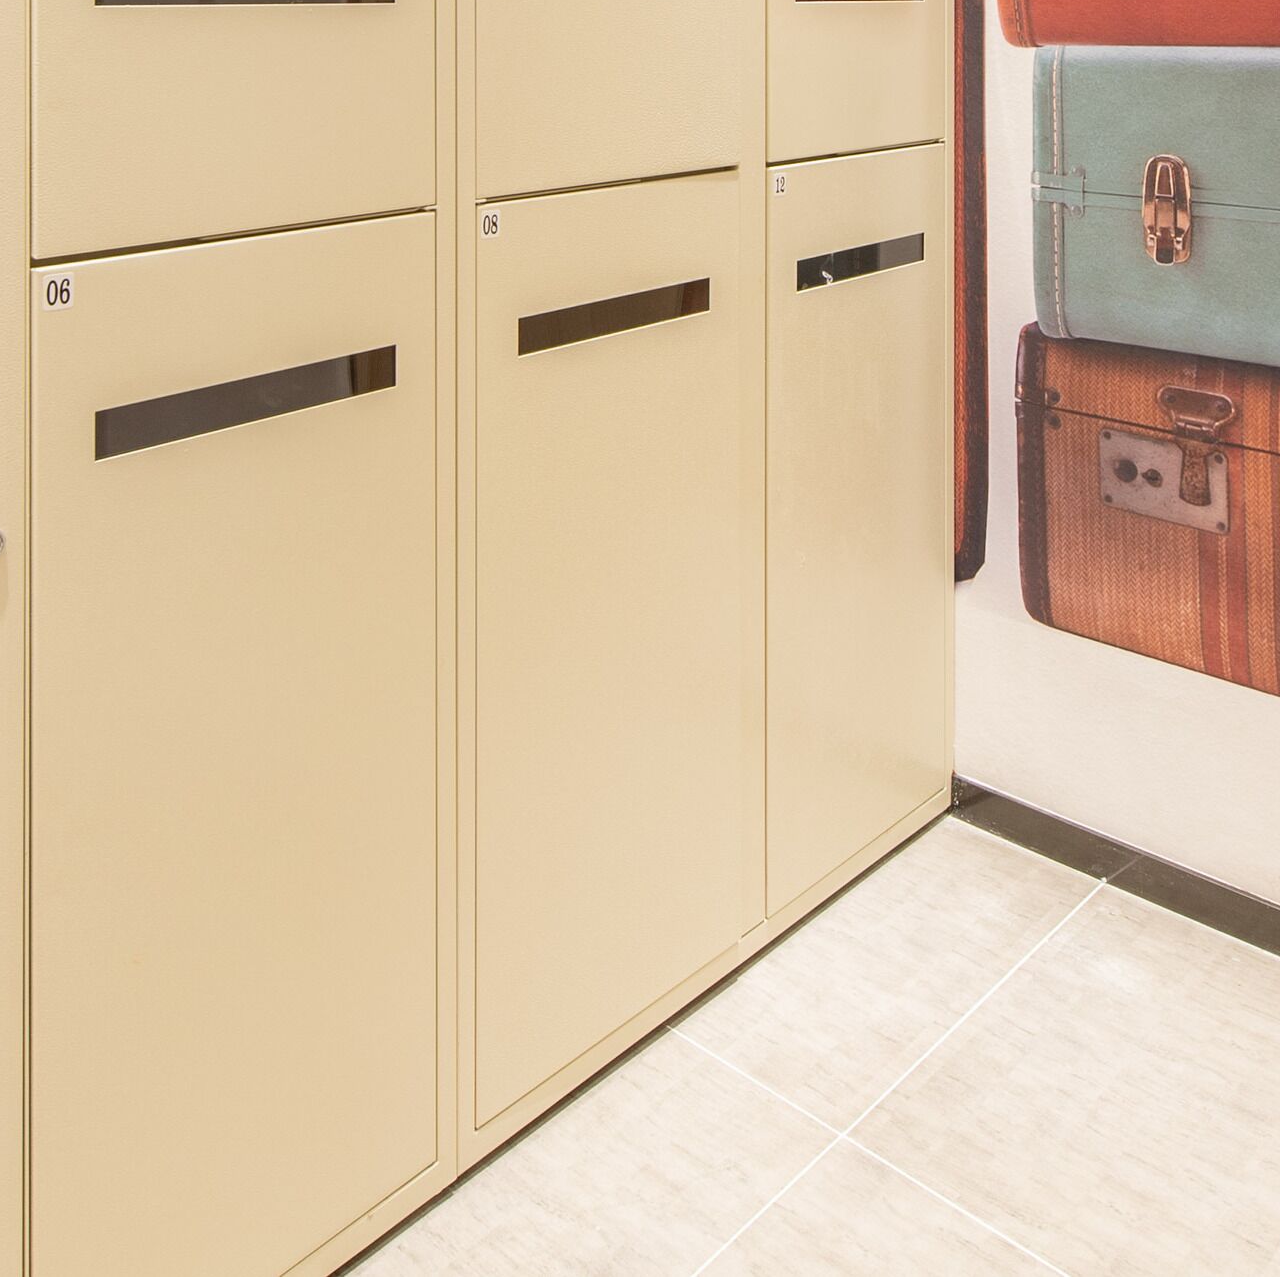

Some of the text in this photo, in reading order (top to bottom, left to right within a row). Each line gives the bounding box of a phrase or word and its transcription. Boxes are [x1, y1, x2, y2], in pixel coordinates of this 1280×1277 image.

[775, 176, 785, 194] 12
[482, 214, 498, 236] 08
[46, 278, 71, 306] 06
